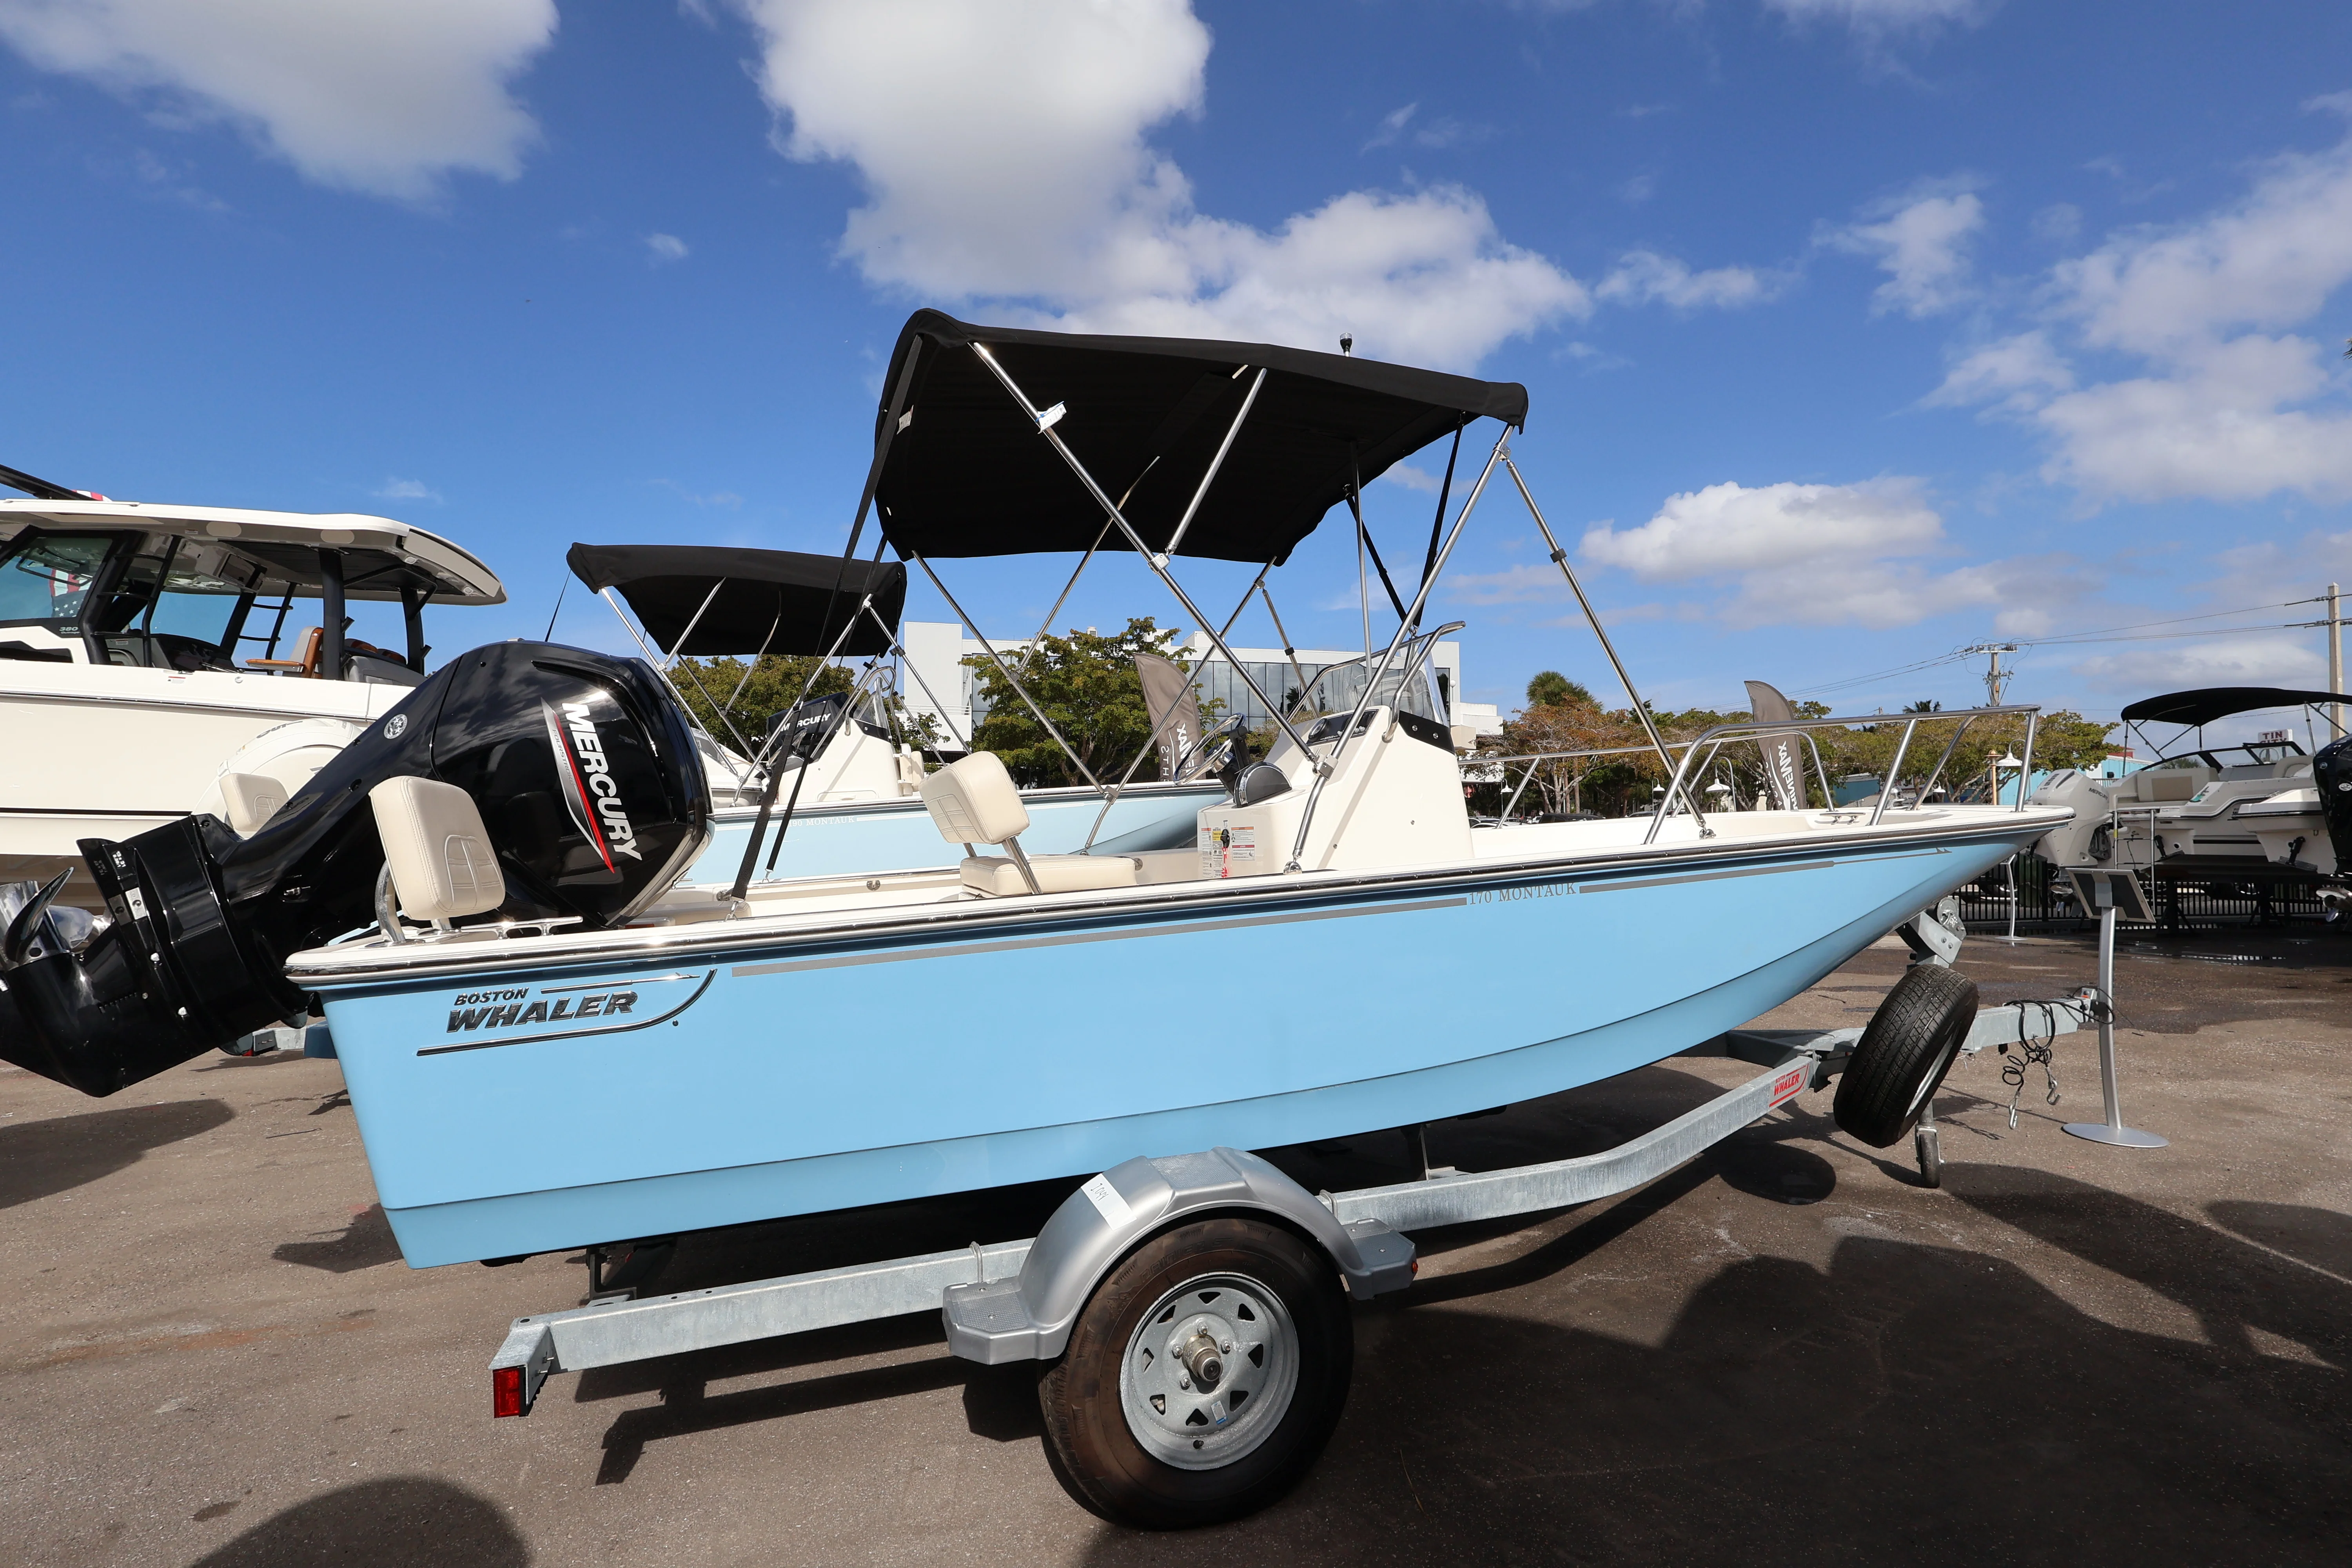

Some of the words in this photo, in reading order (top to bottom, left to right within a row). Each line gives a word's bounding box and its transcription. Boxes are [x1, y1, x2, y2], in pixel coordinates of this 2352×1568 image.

[781, 713, 831, 732] MRCURY
[2262, 731, 2283, 740] TIN
[552, 729, 574, 785] FOURSTROKE
[562, 703, 642, 860] MERCURY
[2089, 787, 2108, 800] MERCURY
[806, 816, 855, 826] MONTAUK
[1469, 891, 1492, 905] 170
[1498, 882, 1576, 902] MONTAUK
[454, 987, 529, 1006] BOSTON
[446, 990, 638, 1033] WHALER
[1774, 1073, 1800, 1096] WHALER
[1140, 1240, 1205, 1283] RAINIER
